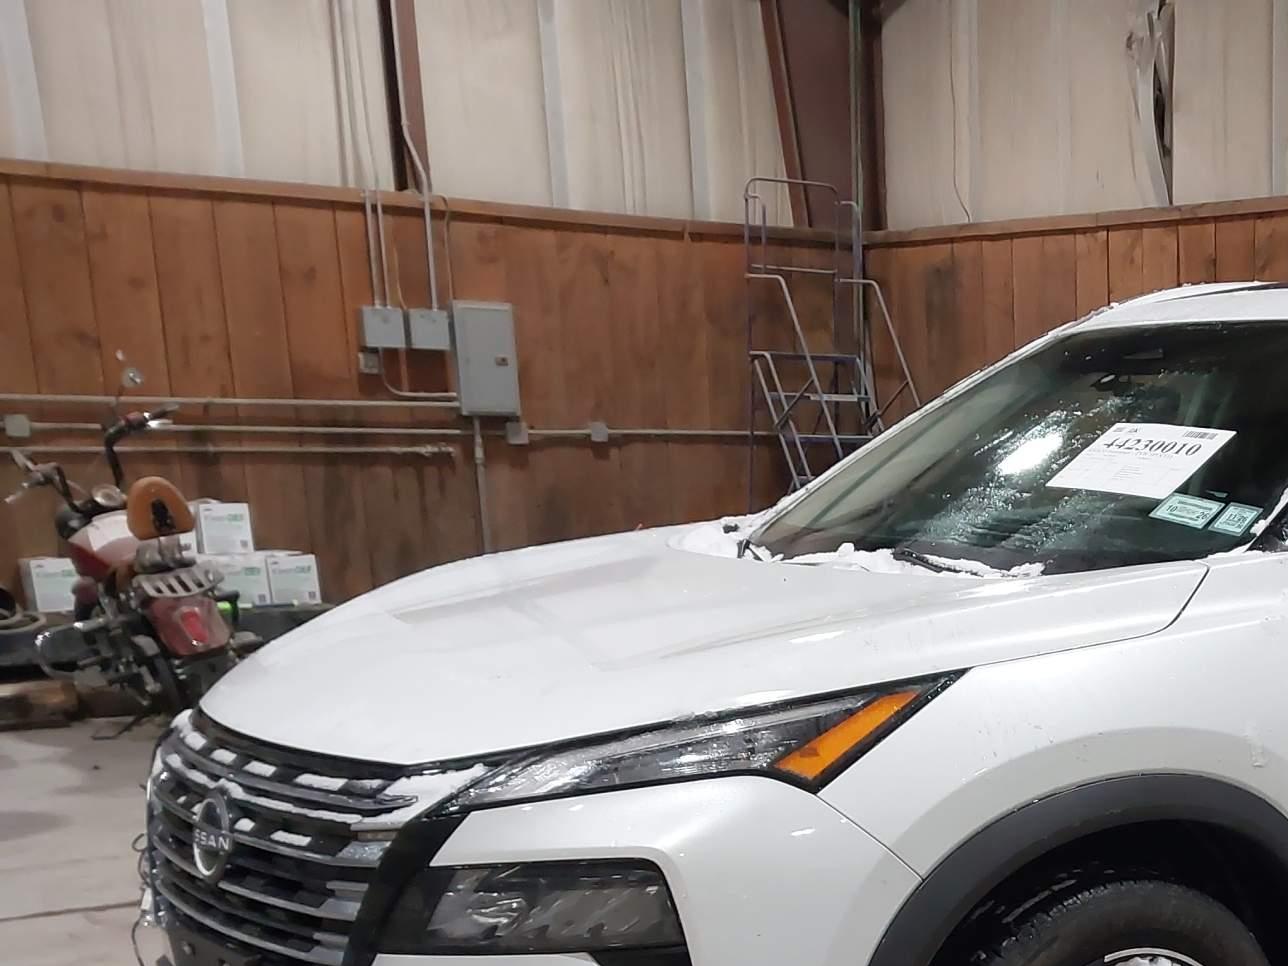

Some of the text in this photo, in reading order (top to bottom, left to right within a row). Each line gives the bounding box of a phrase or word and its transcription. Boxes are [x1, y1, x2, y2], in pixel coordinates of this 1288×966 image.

[1103, 437, 1202, 456] 44230010
[1166, 504, 1178, 513] 10
[1196, 511, 1210, 520] 26
[195, 829, 229, 850] SSAN
